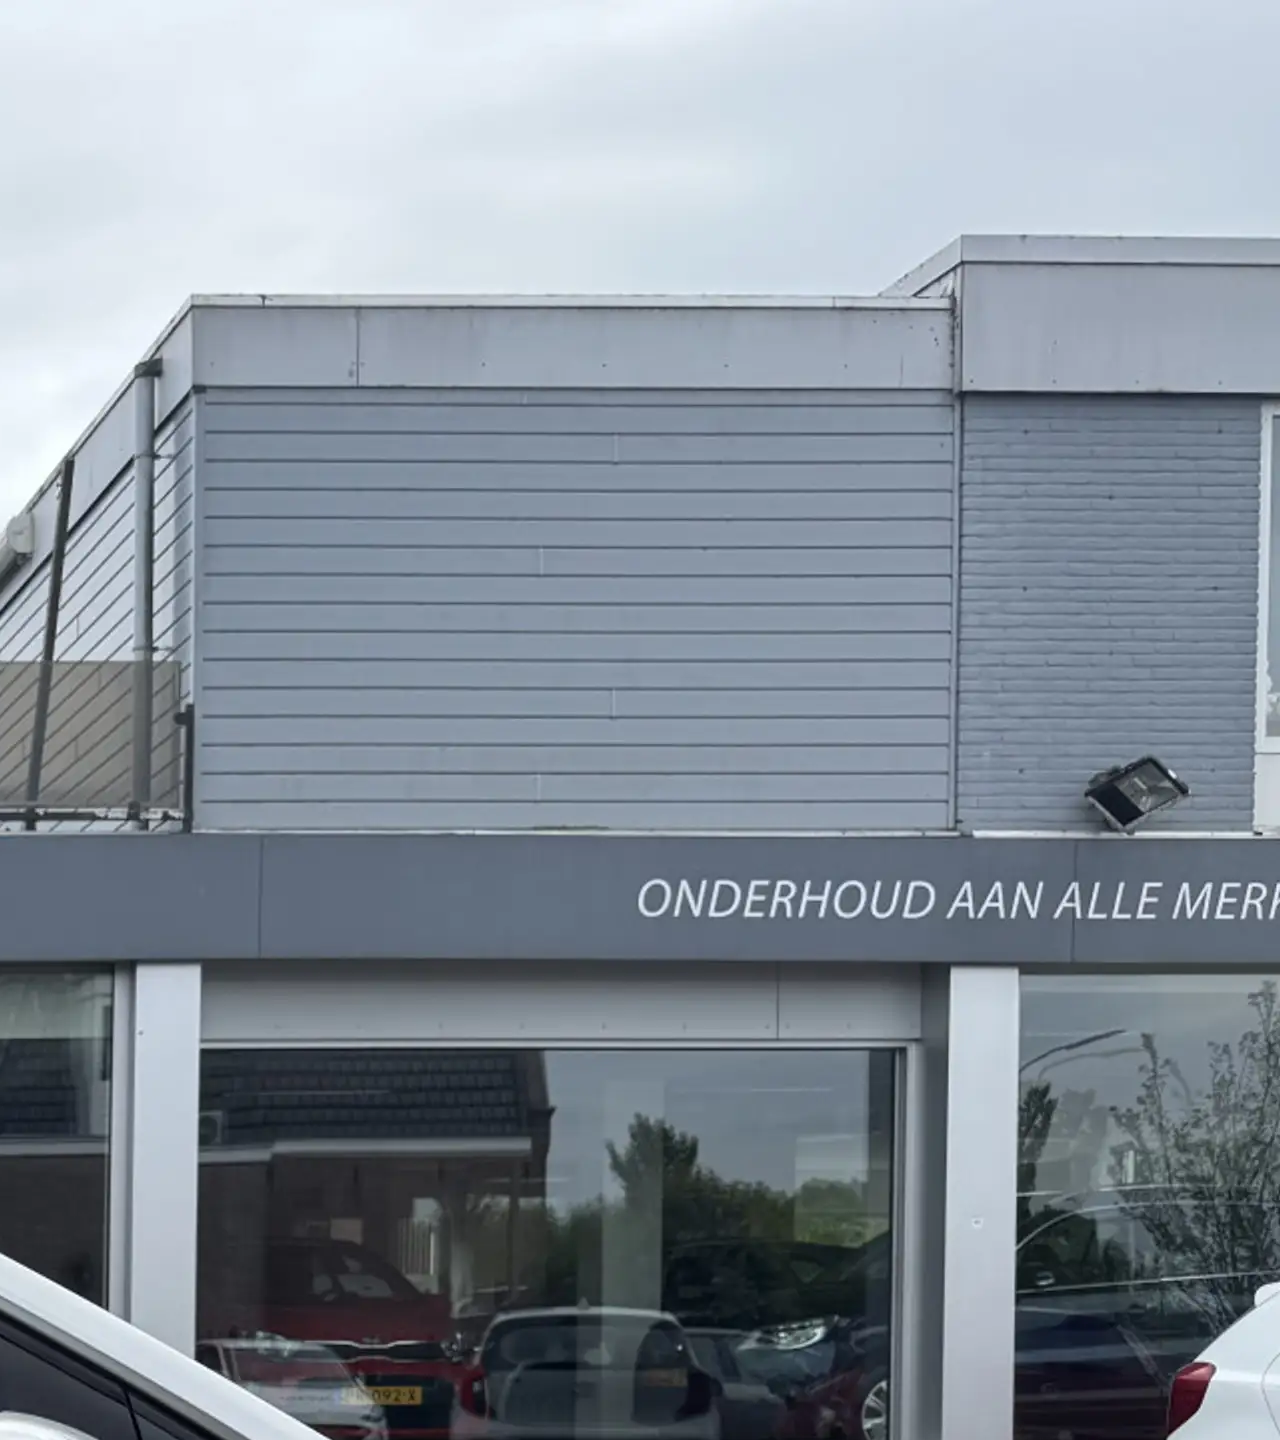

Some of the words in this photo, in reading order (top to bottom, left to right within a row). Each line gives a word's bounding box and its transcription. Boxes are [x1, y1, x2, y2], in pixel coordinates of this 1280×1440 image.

[637, 878, 936, 919] ONDERHOUD
[946, 880, 1044, 920] AAN
[1053, 881, 1163, 920] ALLE
